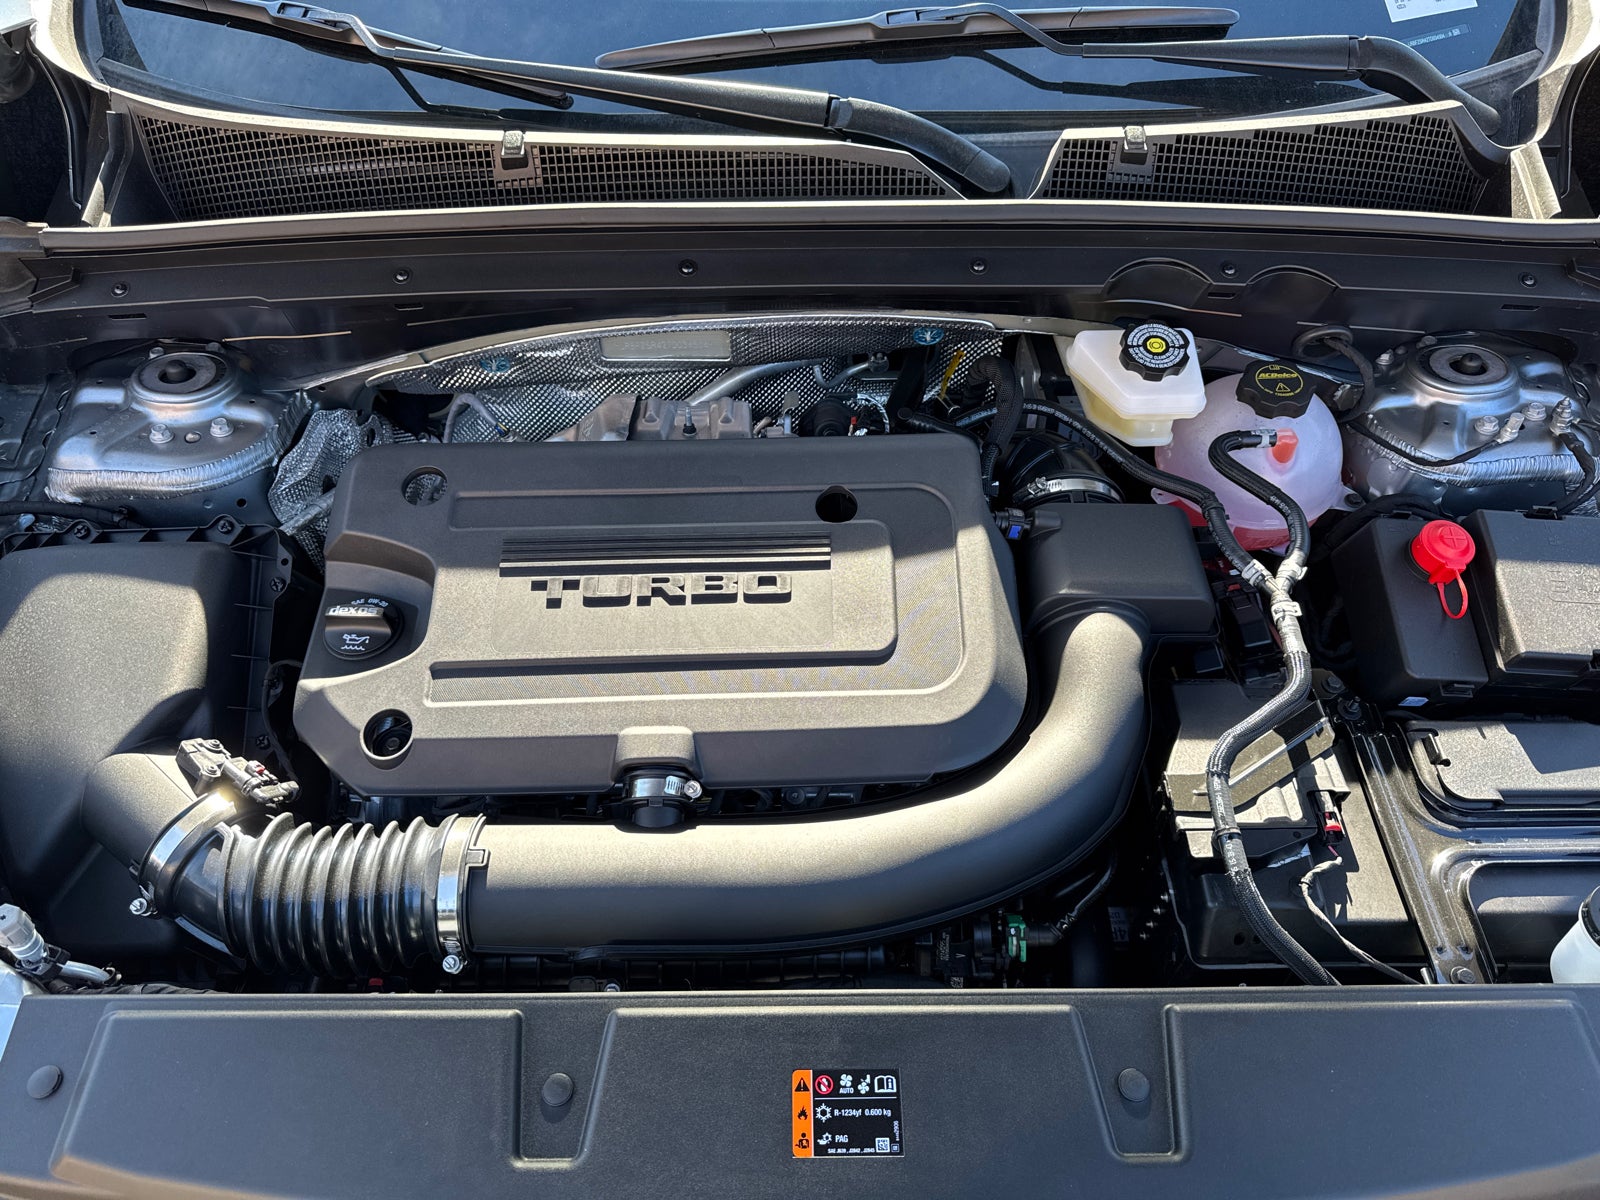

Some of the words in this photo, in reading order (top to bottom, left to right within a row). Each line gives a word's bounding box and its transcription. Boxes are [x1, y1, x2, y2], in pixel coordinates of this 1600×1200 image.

[530, 573, 792, 609] TURBO
[328, 605, 377, 616] dexos
[834, 1108, 862, 1117] R-1234yf
[883, 1108, 892, 1117] kg
[835, 1134, 848, 1142] PAG
